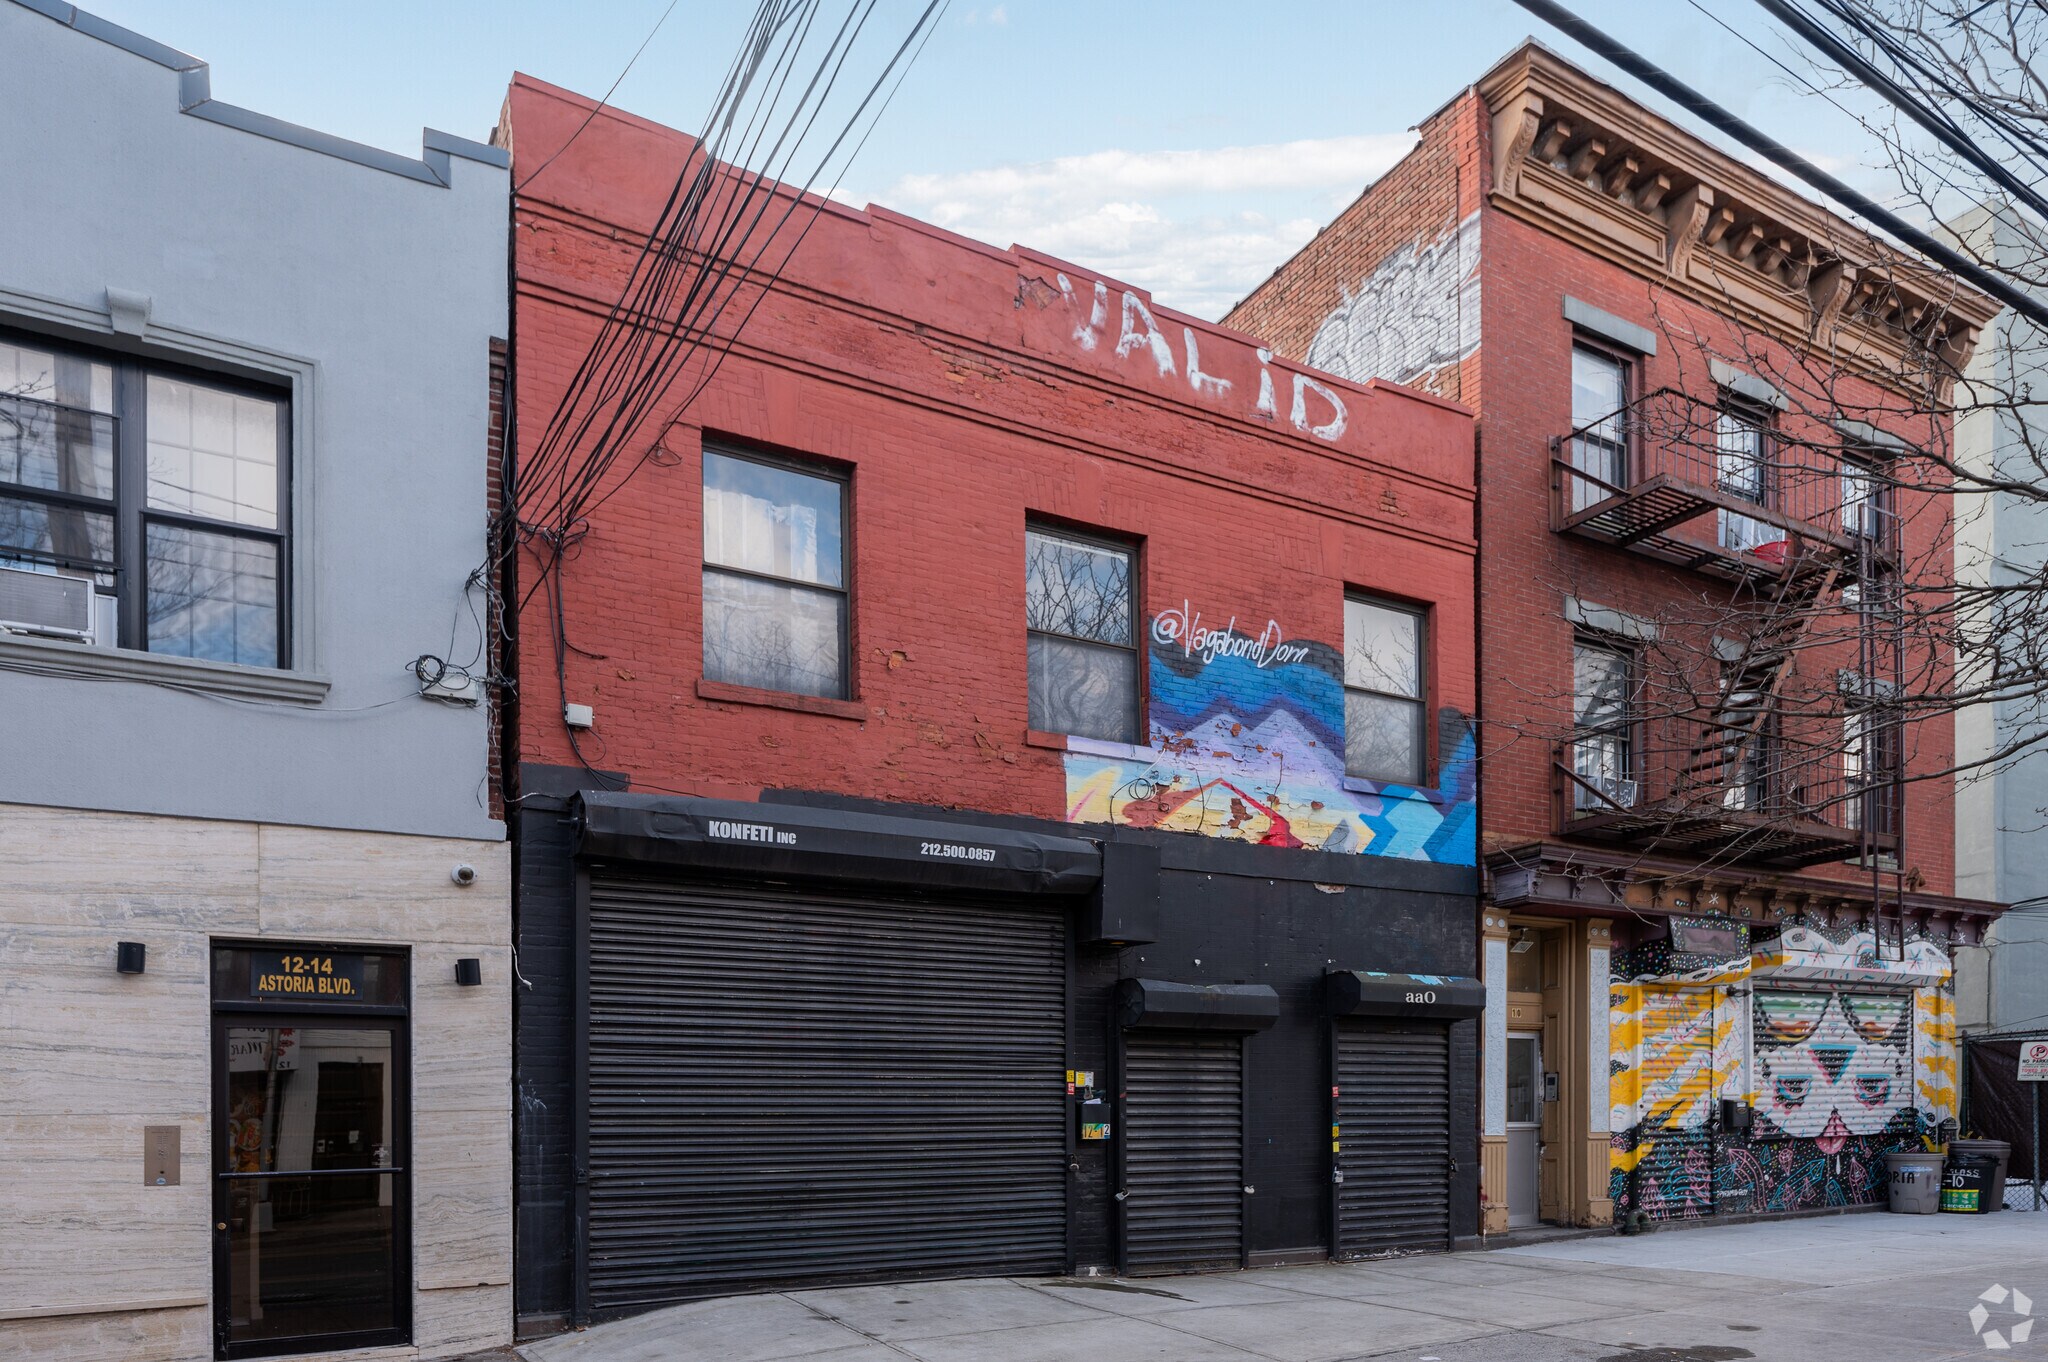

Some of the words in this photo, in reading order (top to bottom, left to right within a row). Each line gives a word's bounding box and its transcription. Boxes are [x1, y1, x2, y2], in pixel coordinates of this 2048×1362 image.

[709, 820, 773, 848] KONFETI
[776, 831, 797, 850] INC
[920, 842, 996, 862] 212.500.0857
[281, 956, 333, 975] 12-14
[258, 975, 315, 993] ASTORIA
[318, 977, 356, 995] BLVD.
